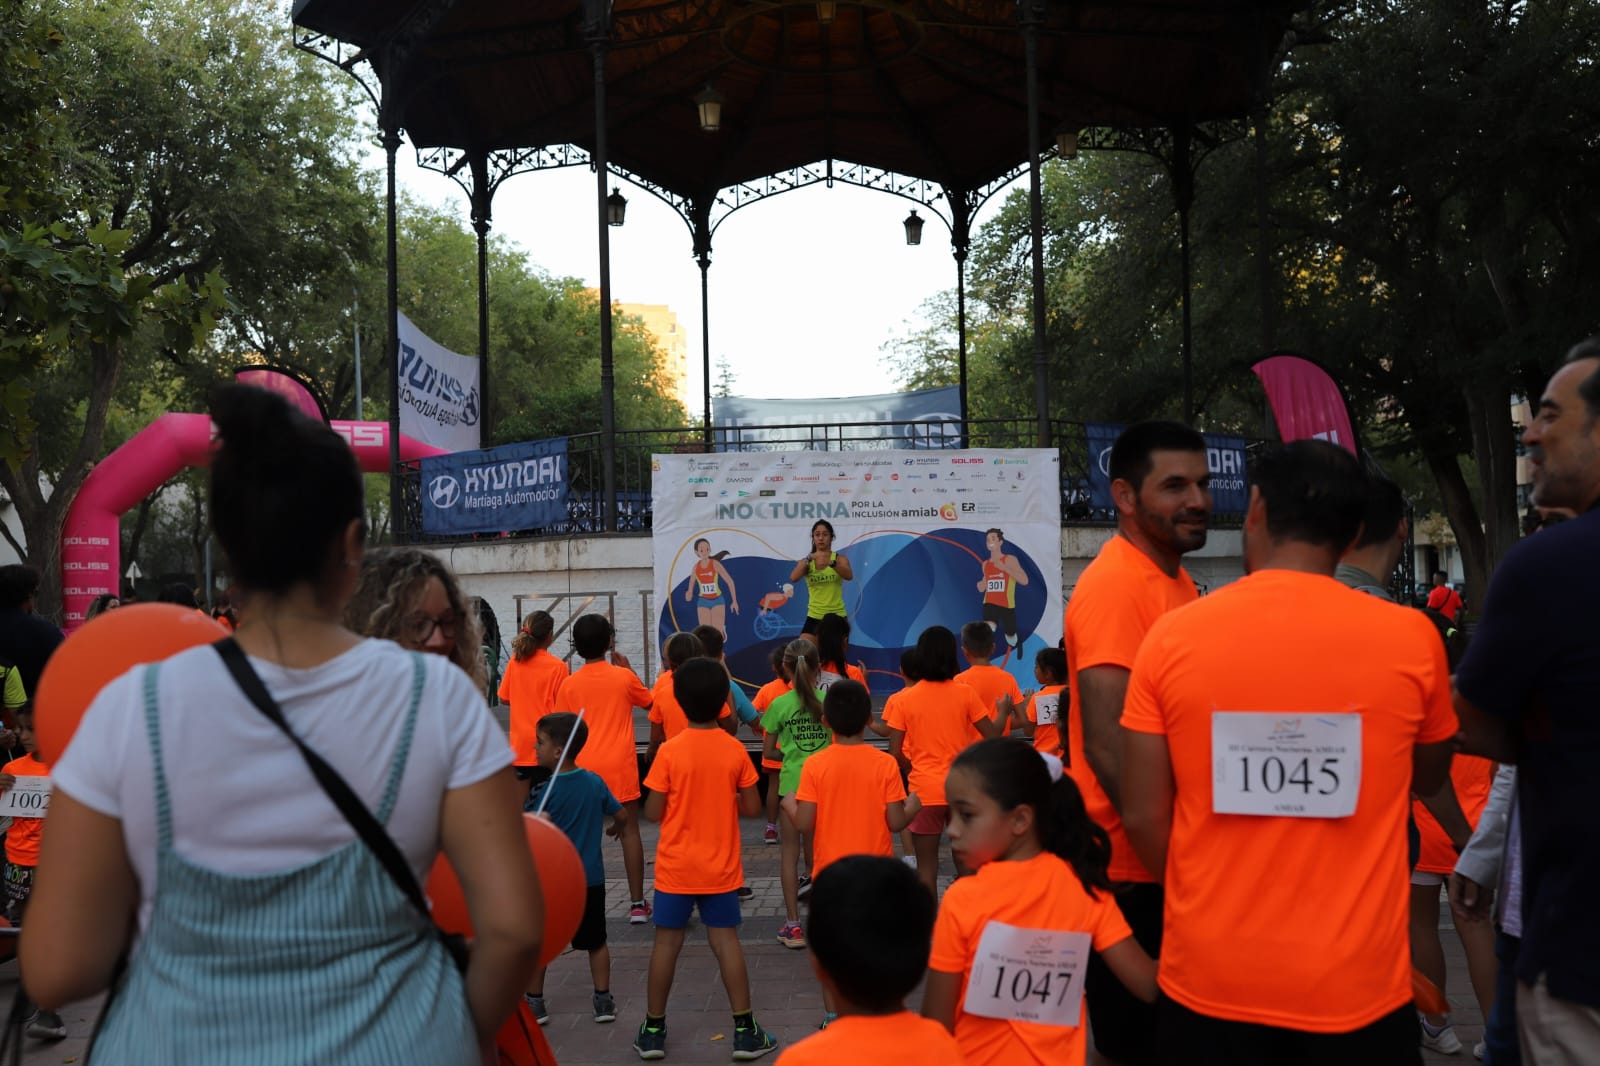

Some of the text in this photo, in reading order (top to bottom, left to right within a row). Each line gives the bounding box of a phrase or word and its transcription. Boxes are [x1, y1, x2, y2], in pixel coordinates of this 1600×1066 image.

[464, 455, 562, 493] HYUNDAI
[465, 493, 502, 509] Martiaga
[719, 502, 850, 519] NOCTURNA
[901, 507, 938, 517] amiab
[63, 537, 109, 545] SOLISS
[63, 562, 109, 570] SOLISS
[63, 587, 109, 595] SOLISS
[702, 584, 715, 593] 112
[988, 581, 1003, 591] 301
[63, 612, 86, 620] SOL
[1240, 756, 1340, 795] 1045
[991, 966, 1073, 1007] 1047
